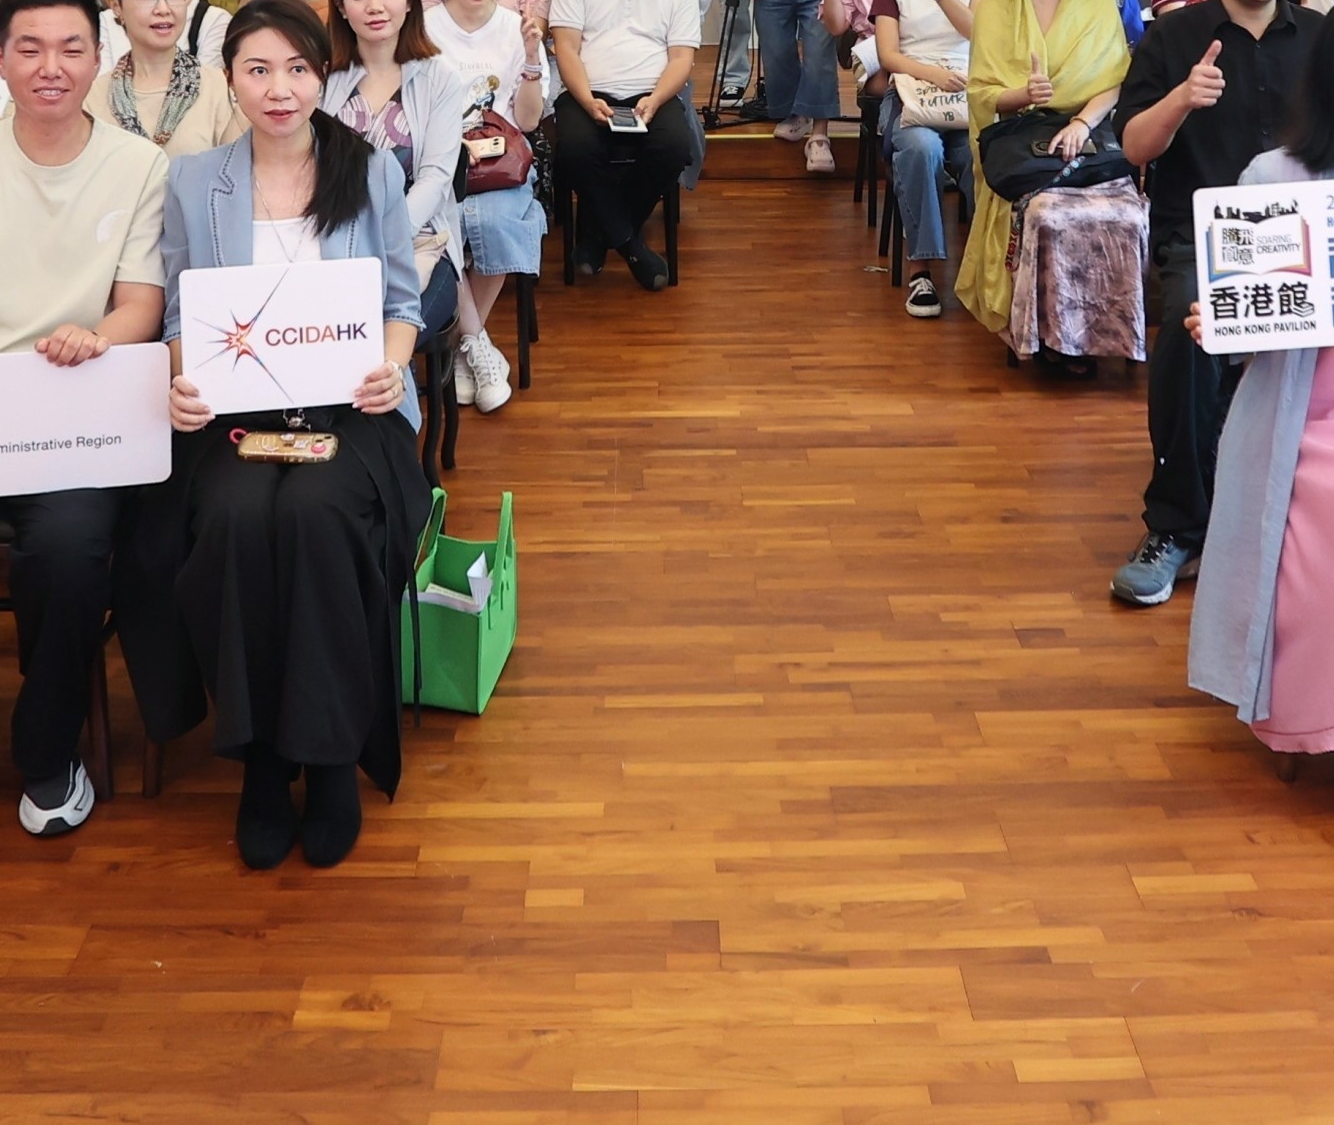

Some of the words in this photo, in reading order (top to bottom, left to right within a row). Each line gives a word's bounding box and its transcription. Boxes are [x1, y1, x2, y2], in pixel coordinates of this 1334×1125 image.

[919, 93, 966, 107] FUTUR
[1256, 234, 1292, 244] SOARING
[1256, 243, 1301, 254] CREATIVITY
[1209, 281, 1315, 321] 香港館
[266, 322, 368, 346] CCIDAHK
[1214, 325, 1242, 336] HONG
[1244, 323, 1271, 335] KONG
[1274, 320, 1317, 332] PAVILION
[76, 434, 122, 449] Region
